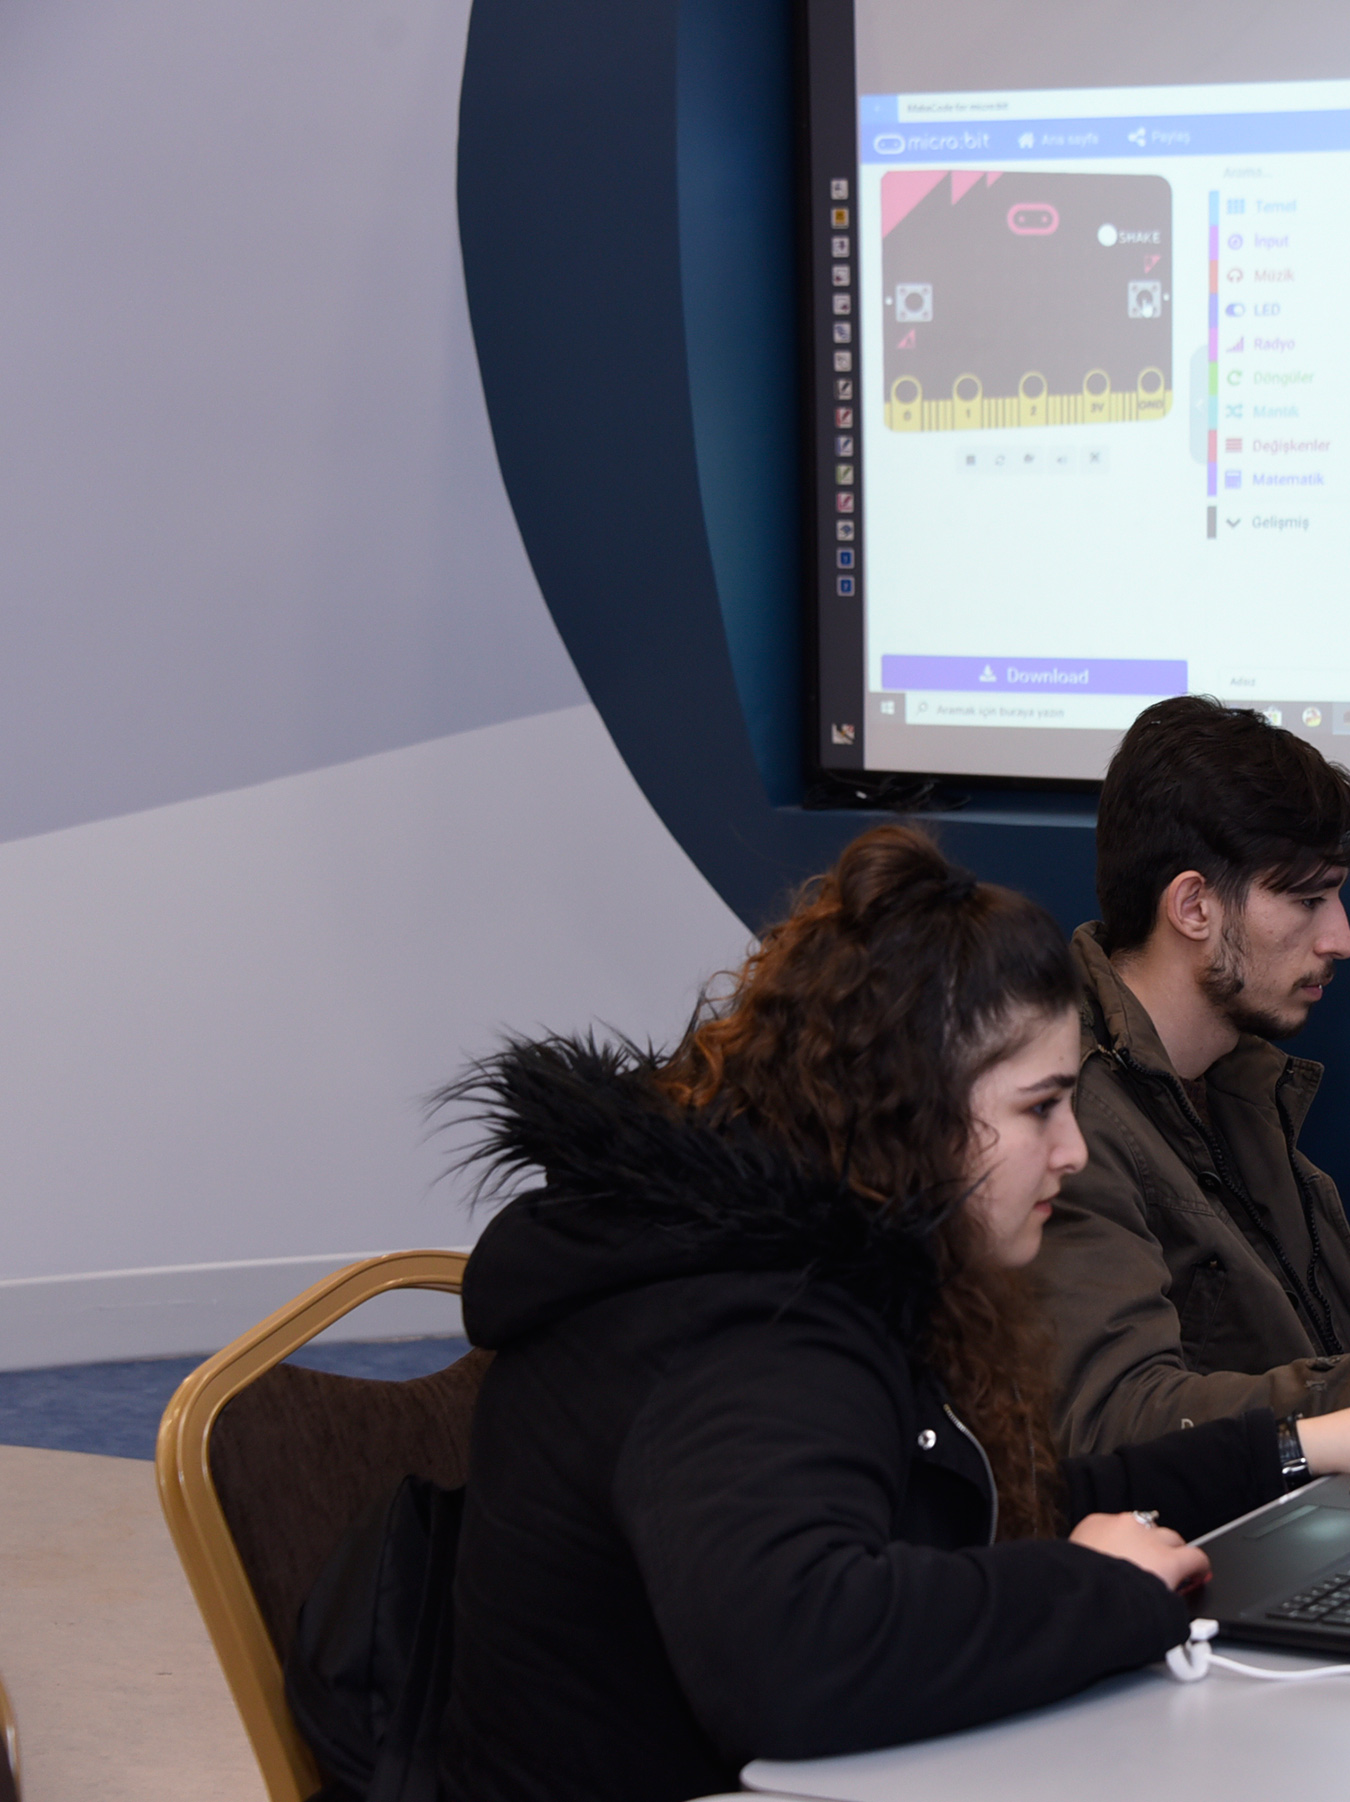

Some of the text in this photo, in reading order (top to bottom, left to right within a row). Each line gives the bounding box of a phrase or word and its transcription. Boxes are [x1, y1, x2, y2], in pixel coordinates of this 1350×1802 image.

[907, 131, 991, 151] micro:bit
[1256, 198, 1298, 214] Temel
[1118, 230, 1162, 245] SHAKE
[1253, 267, 1296, 283] Müzik
[1253, 302, 1282, 317] LED
[1253, 337, 1297, 353] Radyo
[1252, 438, 1331, 456] Değişkenler
[1252, 471, 1326, 486] Matematik
[1251, 514, 1310, 532] Gelişmiş
[1006, 666, 1090, 686] Download
